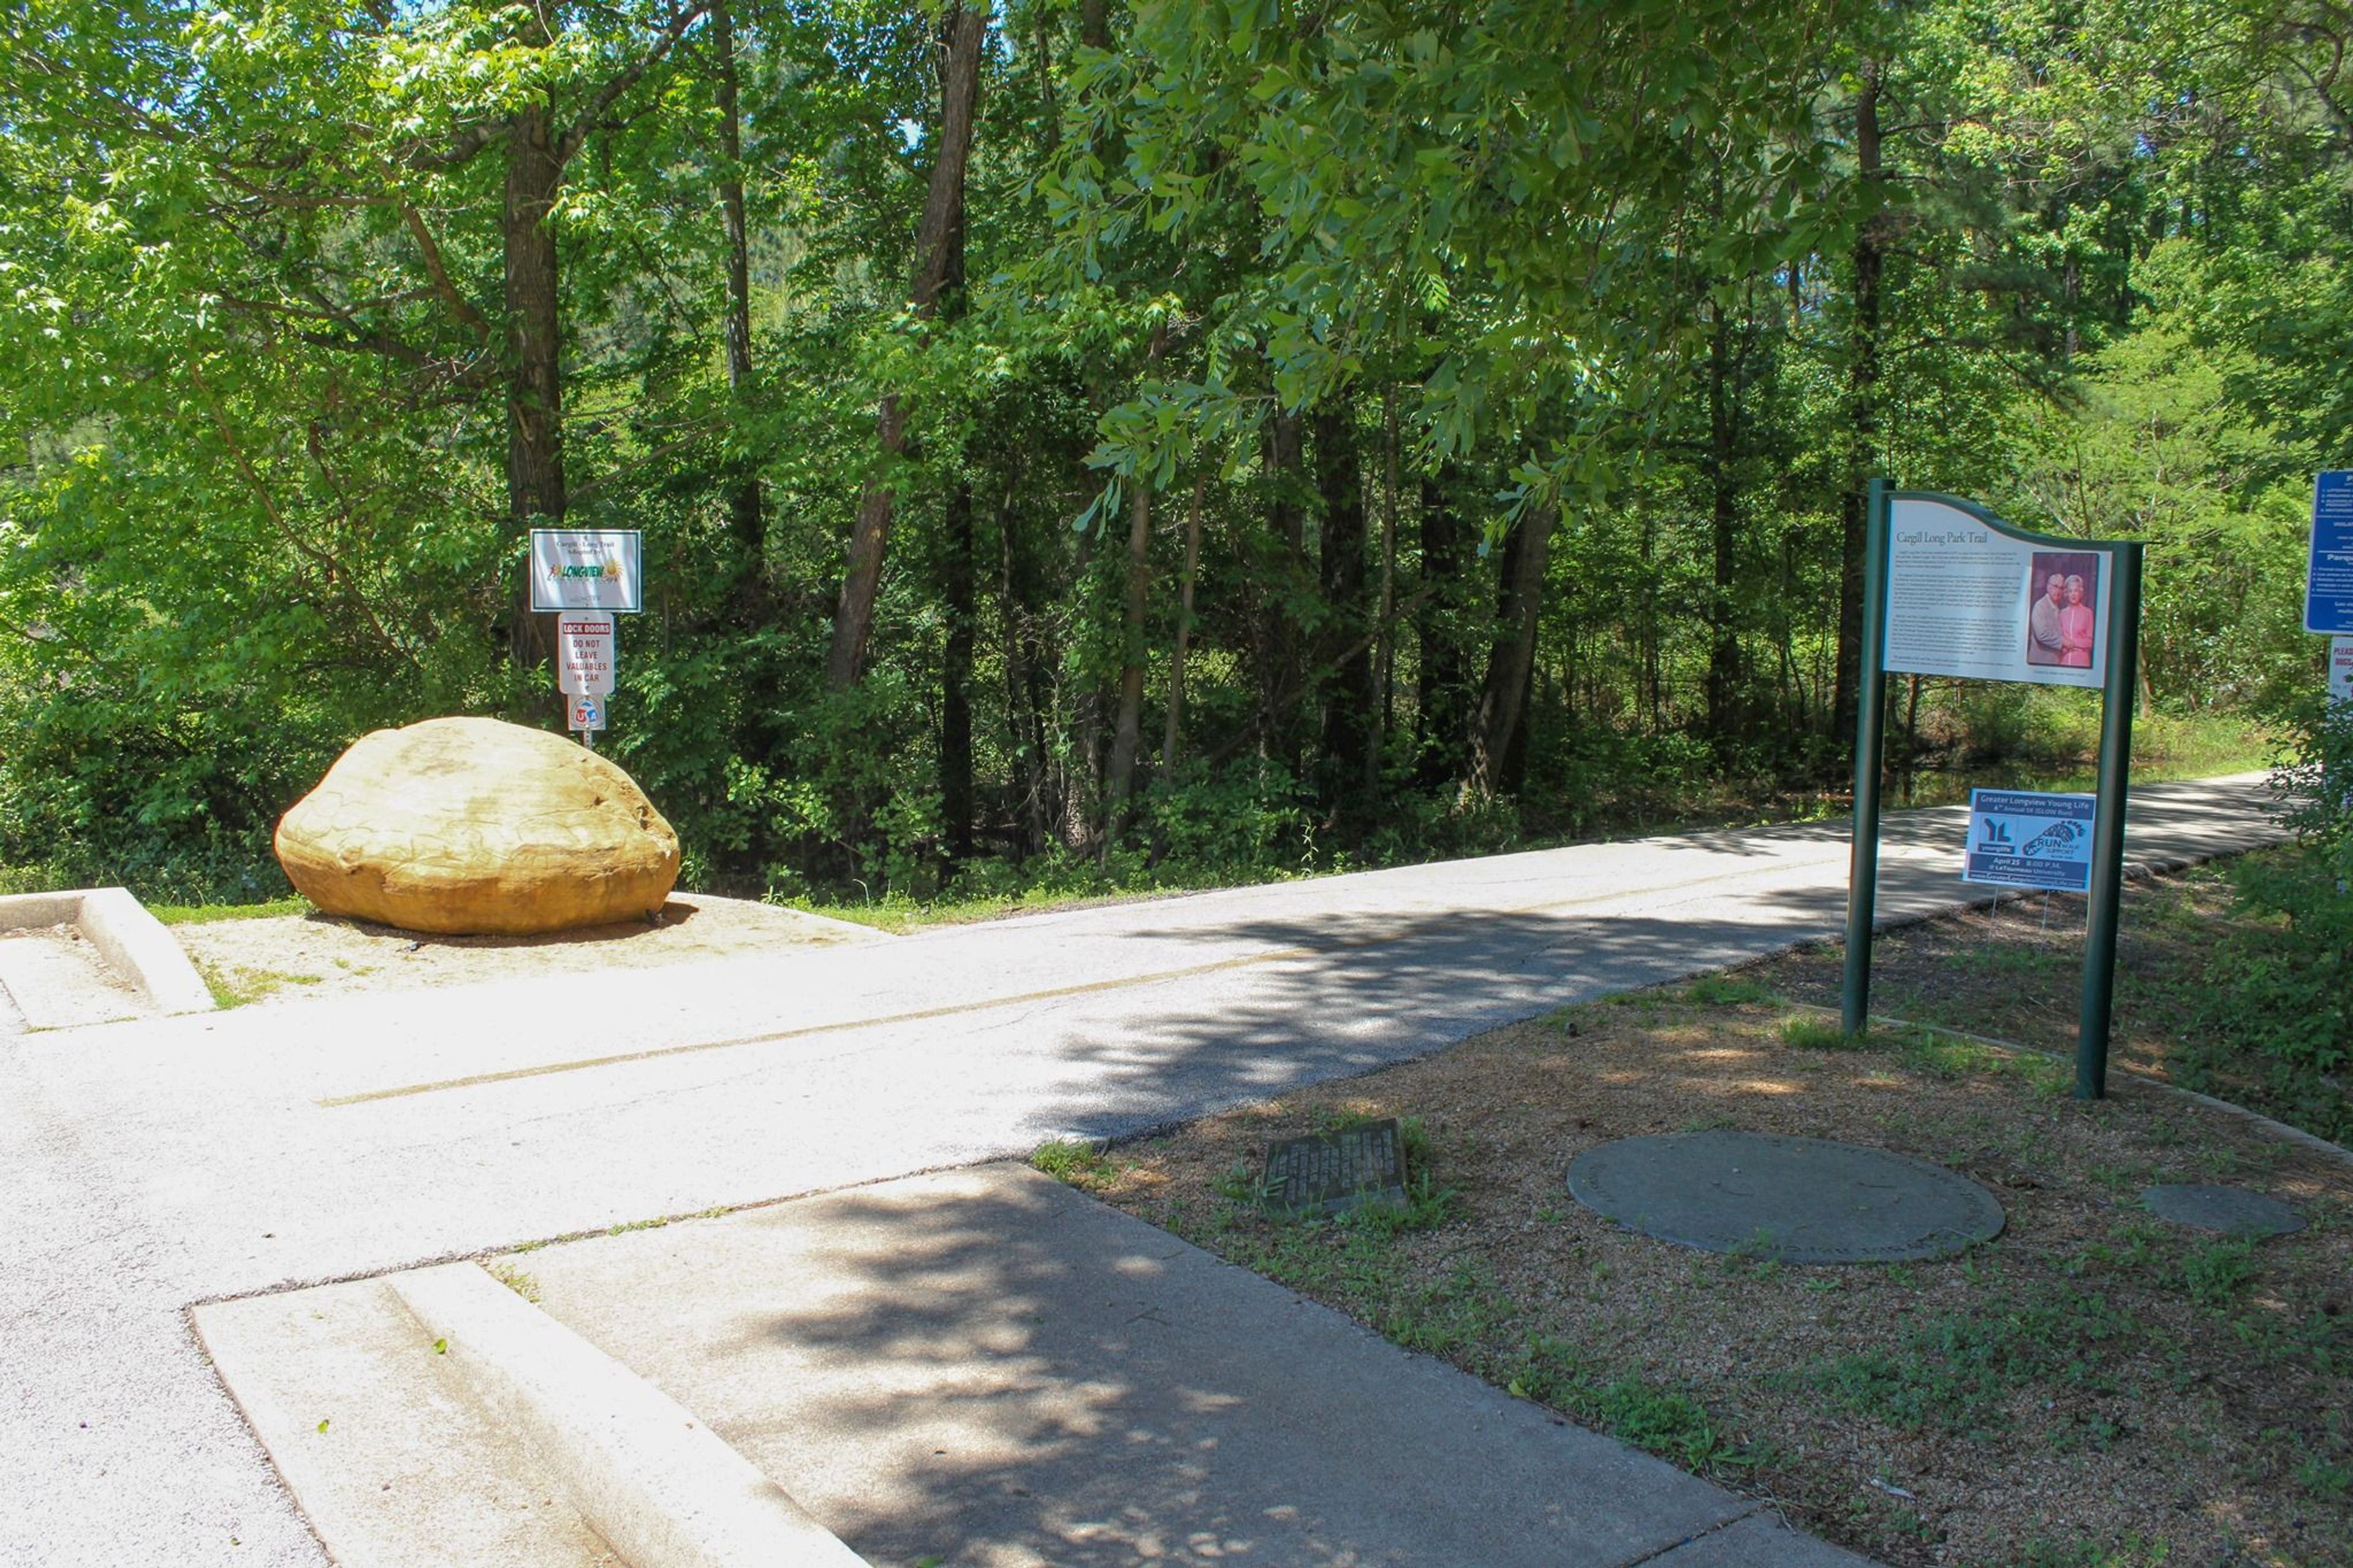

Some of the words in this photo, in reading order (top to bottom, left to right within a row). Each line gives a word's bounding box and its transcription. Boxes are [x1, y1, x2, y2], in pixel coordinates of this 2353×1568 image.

[1896, 532, 1922, 546] Cargill
[1925, 532, 1946, 547] Long
[1947, 532, 1966, 543] Park
[1968, 532, 1988, 543] Trail
[562, 566, 605, 578] LONGVIEW
[564, 624, 583, 633] LOCK
[585, 624, 610, 633] DOORS
[577, 711, 598, 722] USA
[1980, 795, 2009, 803] Greater
[2010, 797, 2046, 808] Longview
[2048, 800, 2072, 809] Young
[1984, 818, 2011, 842] YL
[2037, 837, 2061, 847] RUN
[2033, 868, 2066, 877] University
